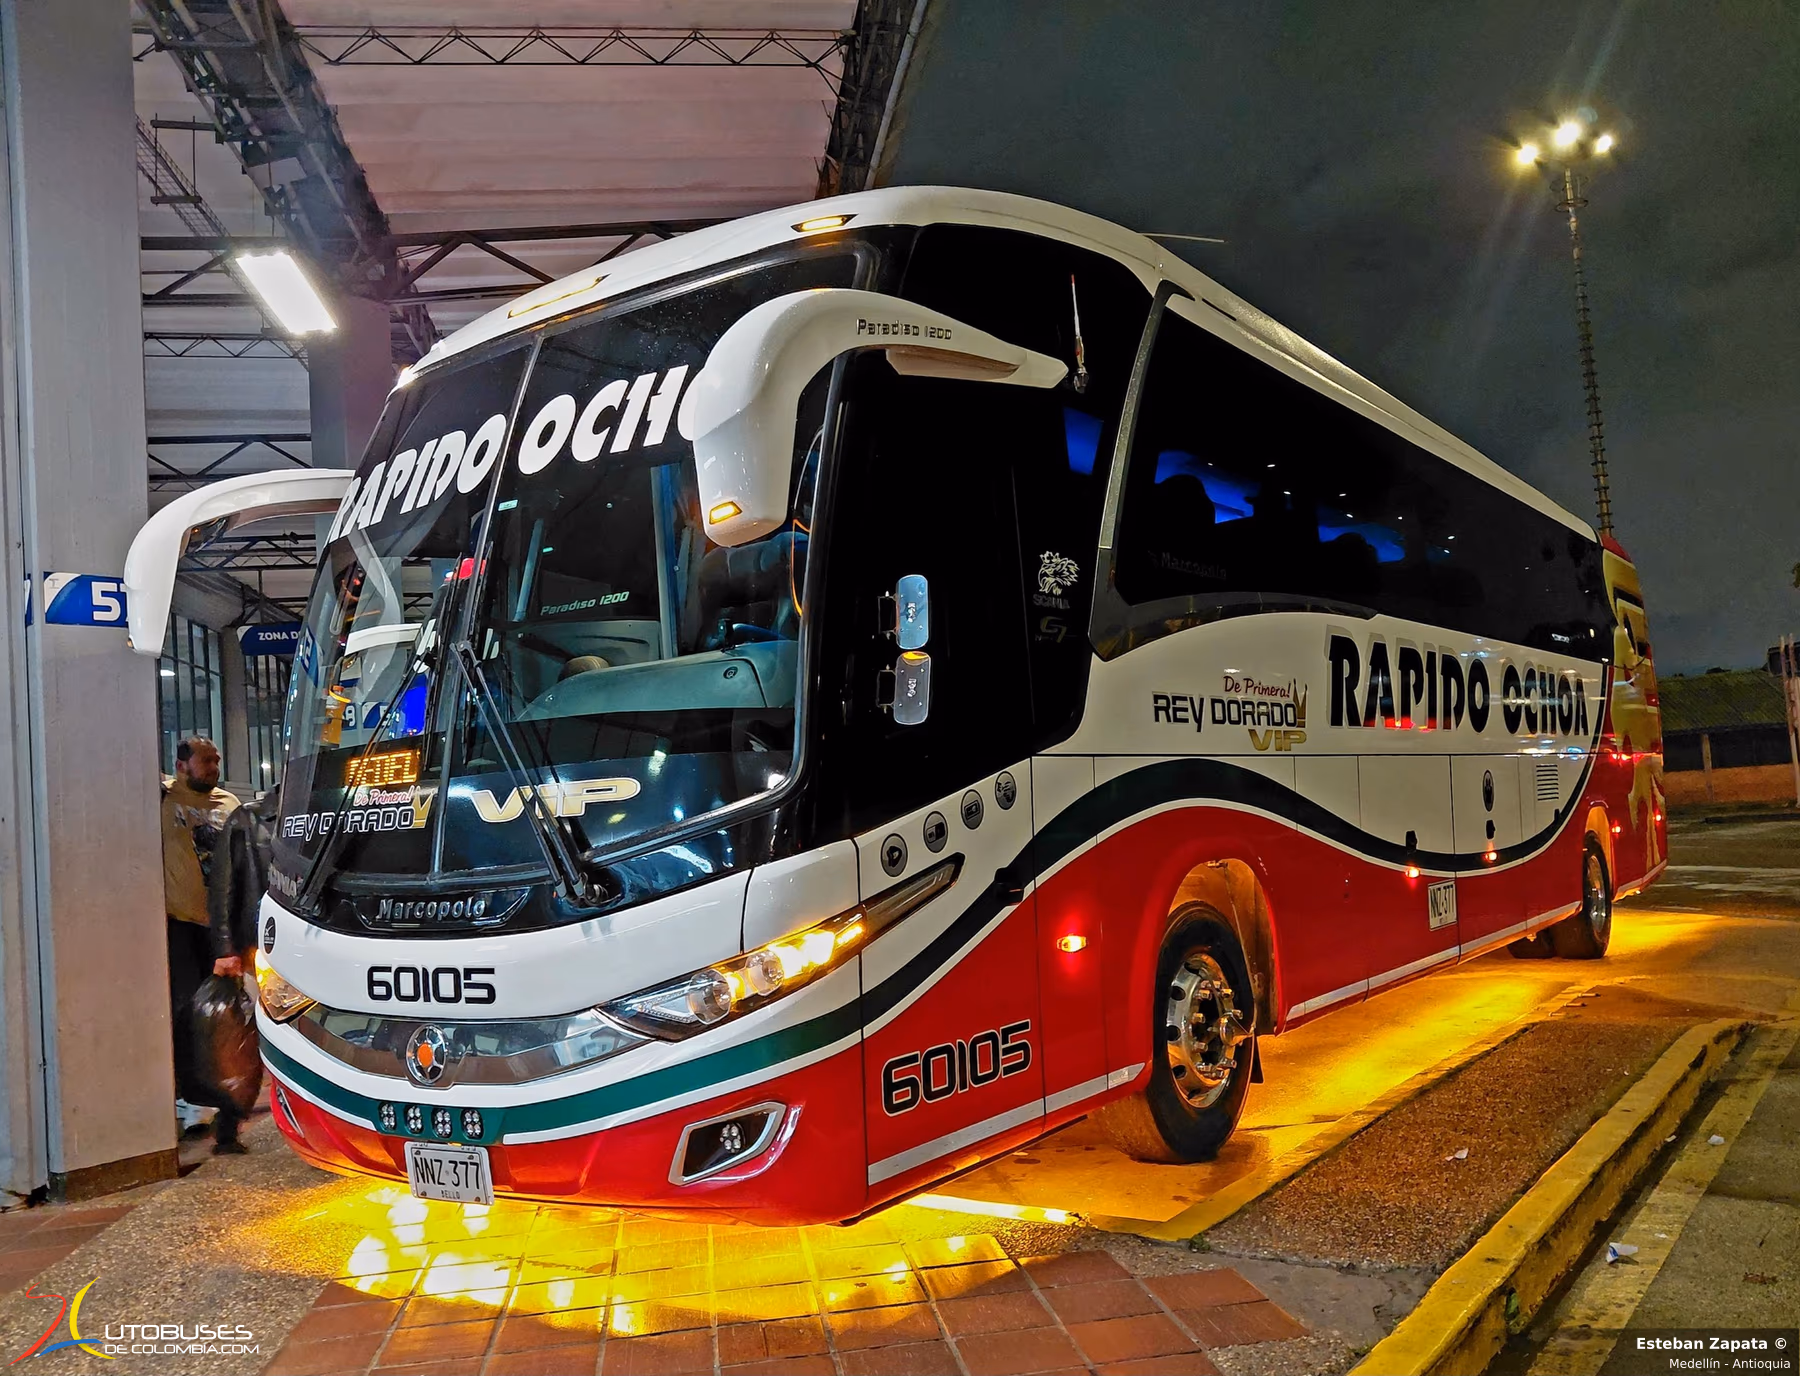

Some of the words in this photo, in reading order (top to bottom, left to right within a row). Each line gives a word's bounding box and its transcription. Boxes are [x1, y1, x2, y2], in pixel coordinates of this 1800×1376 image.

[857, 319, 920, 336] Paradiso
[924, 326, 953, 340] 1200
[328, 413, 507, 544] RAPIDO
[91, 581, 128, 622] 5
[540, 599, 597, 616] Paradiso
[599, 591, 630, 605] 1200
[257, 632, 289, 641] ZONA
[290, 631, 301, 640] D
[1223, 675, 1241, 692] De
[1243, 678, 1291, 698] Primera!
[1326, 626, 1491, 733] RAPIDO
[1502, 660, 1589, 736] OCHOA
[1152, 692, 1204, 733] REY
[1209, 697, 1297, 727] DORADO
[1248, 729, 1307, 751] VIP
[353, 791, 368, 806] De
[471, 777, 642, 823] VIP
[282, 813, 318, 841] REY
[379, 896, 486, 921] Marcopolo
[366, 964, 497, 1005] 60105
[882, 1018, 1032, 1117] 60105
[414, 1156, 446, 1186] NNZ
[448, 1160, 480, 1190] 377
